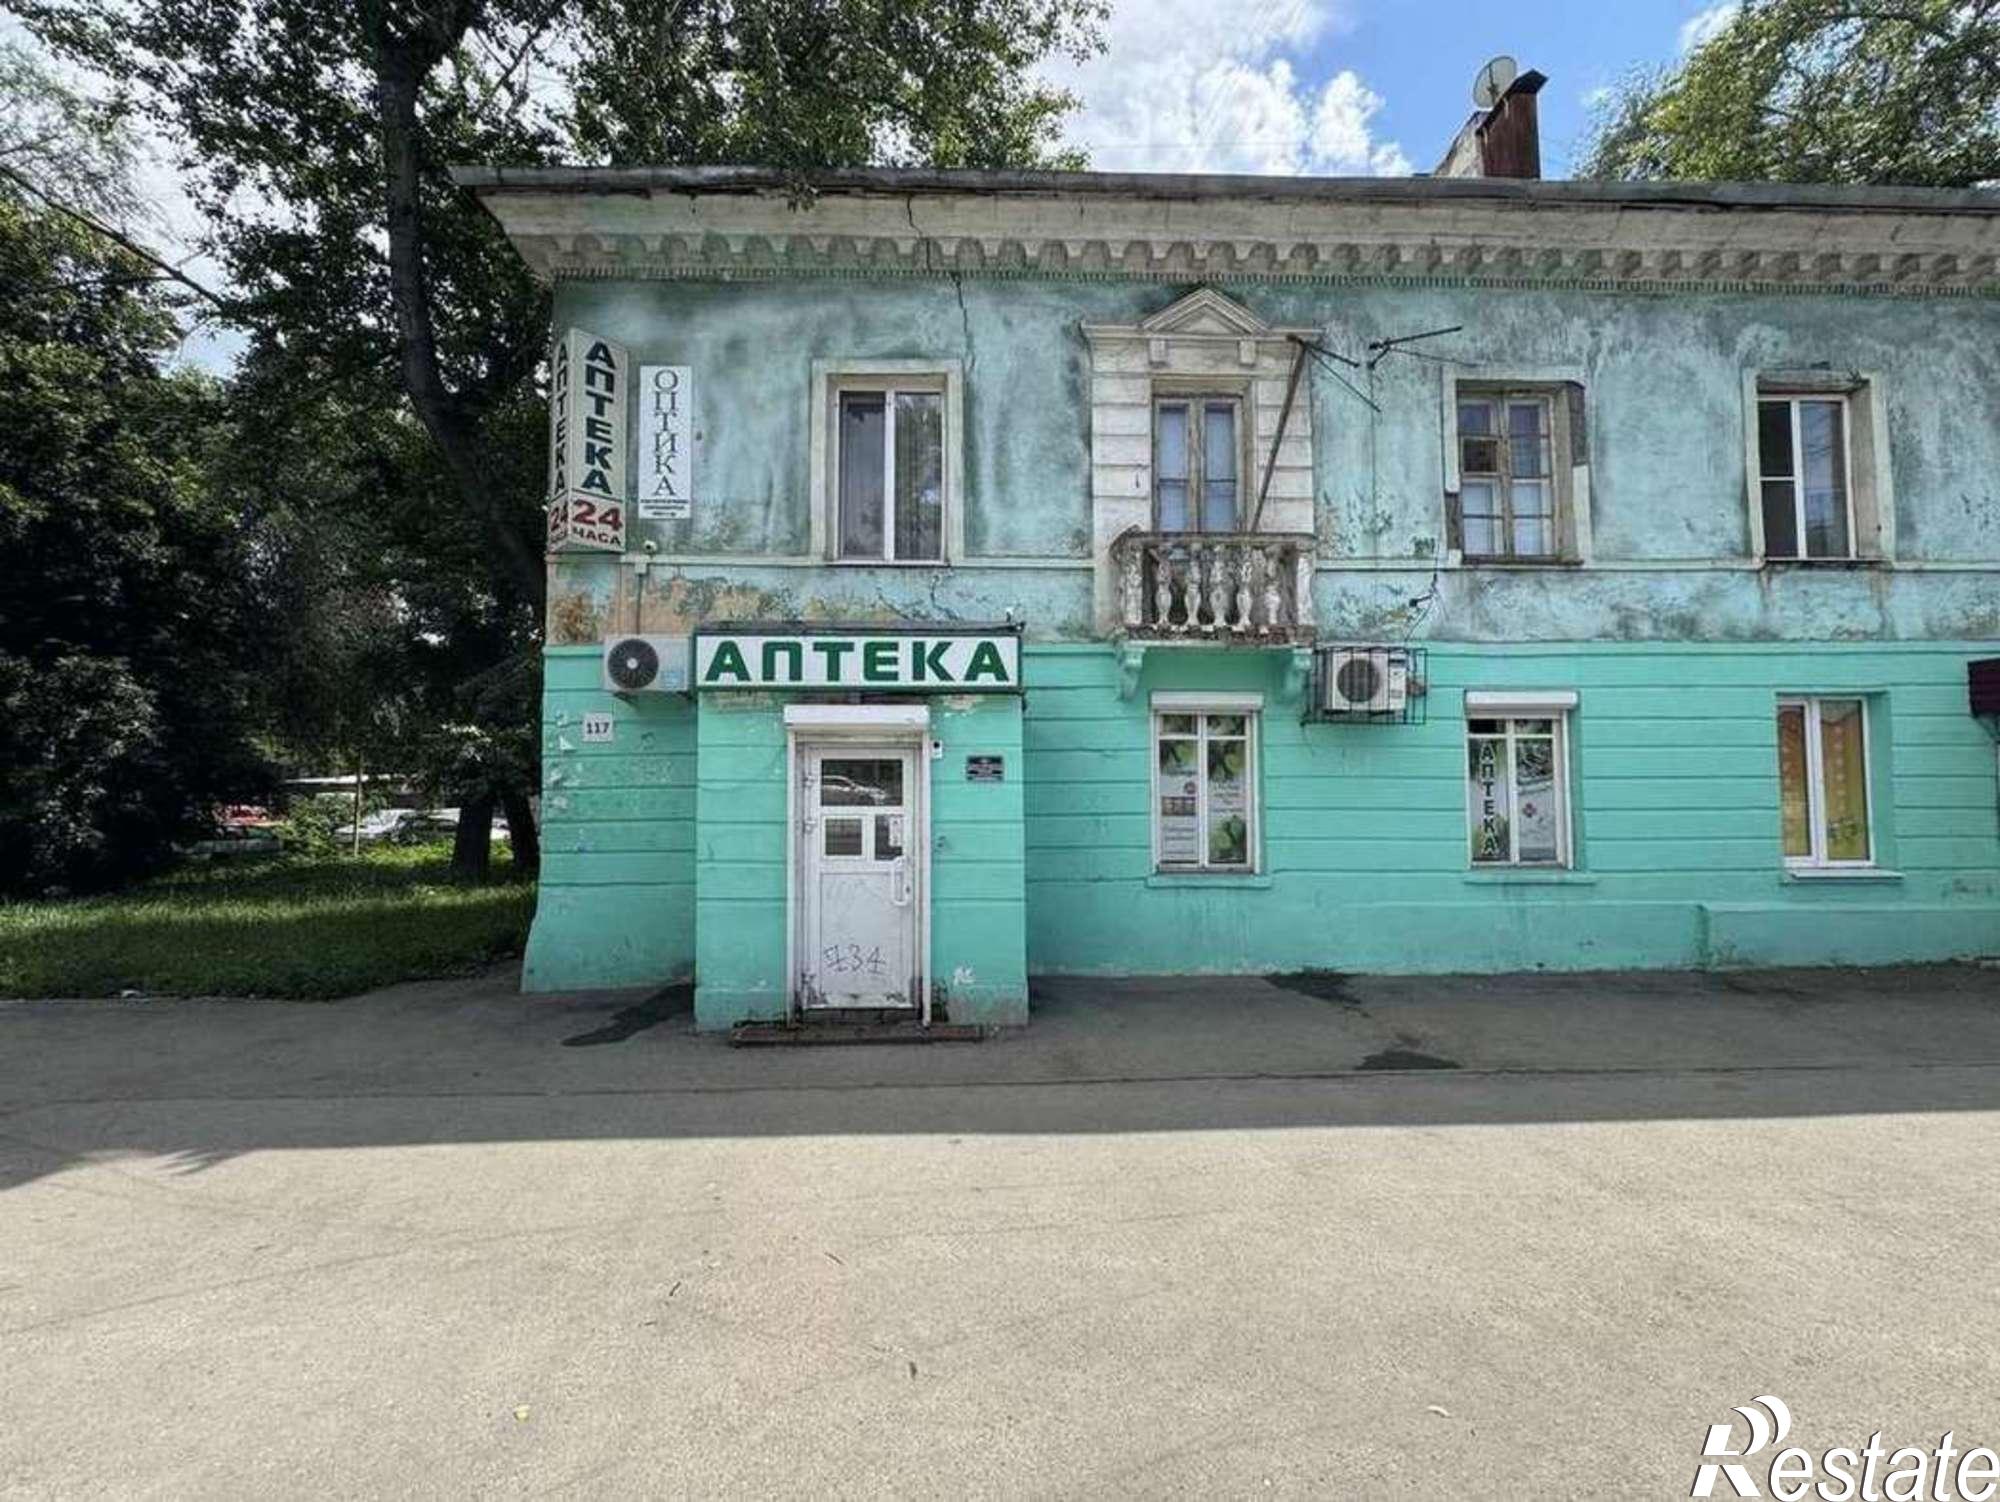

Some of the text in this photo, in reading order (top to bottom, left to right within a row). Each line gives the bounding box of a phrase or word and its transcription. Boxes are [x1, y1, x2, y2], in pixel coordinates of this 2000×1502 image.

[554, 343, 567, 495] АПТЕКА
[582, 342, 615, 495] АПТЕКА
[654, 370, 678, 496] ОПТИКА
[573, 500, 622, 531] 24
[573, 527, 620, 545] ЧАСА
[705, 640, 1009, 682] АПТЕКА
[587, 722, 609, 734] 117
[1480, 744, 1496, 855] АПТЕКА
